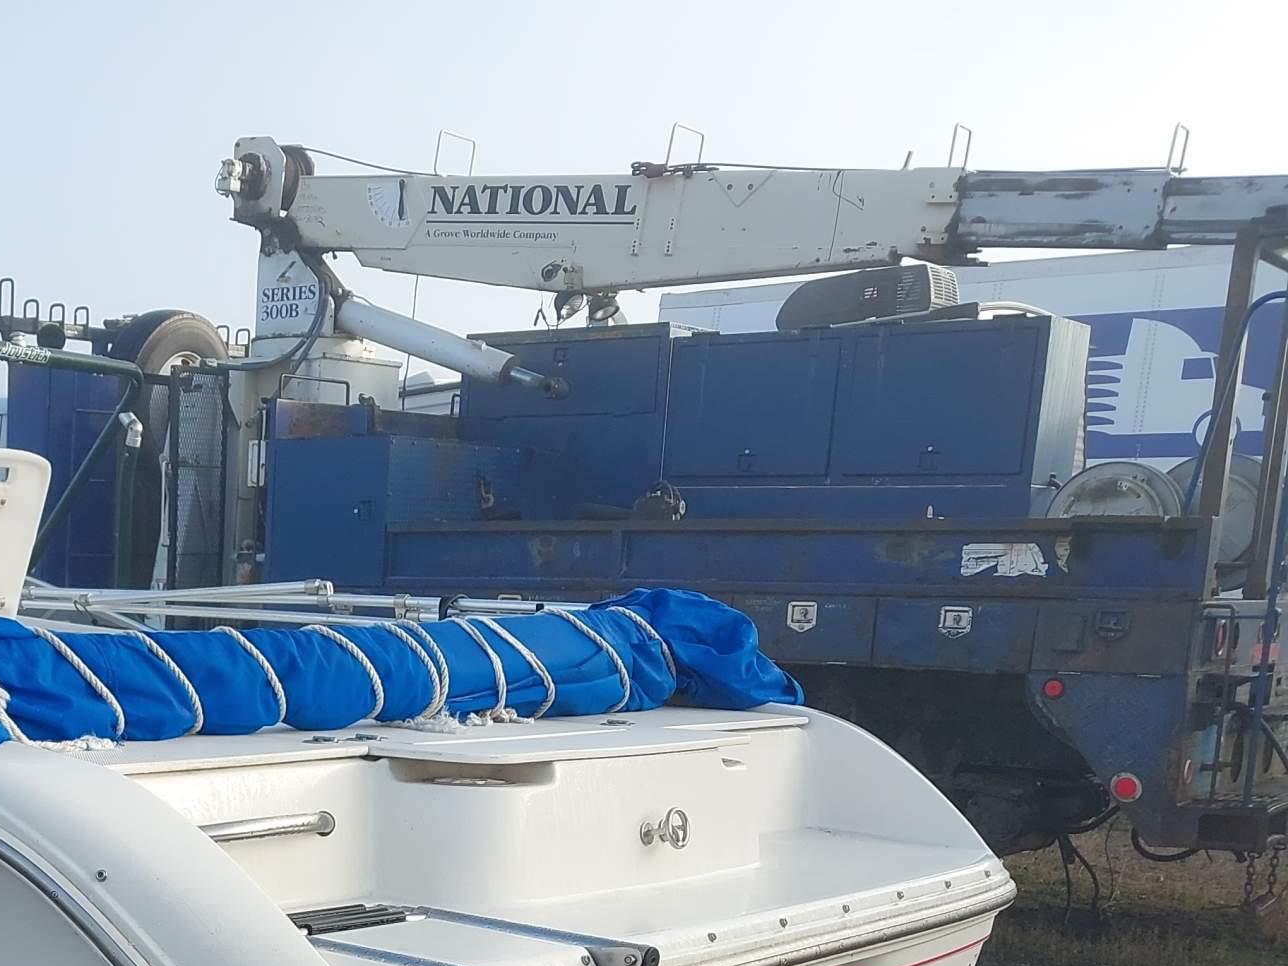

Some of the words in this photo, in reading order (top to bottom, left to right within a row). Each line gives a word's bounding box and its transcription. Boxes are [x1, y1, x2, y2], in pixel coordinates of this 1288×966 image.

[427, 183, 637, 216] NATIONAL
[433, 229, 461, 239] Grove
[463, 229, 511, 240] Worldwide
[513, 230, 558, 242] Company
[261, 284, 316, 302] SERIES
[261, 303, 299, 321] 300B
